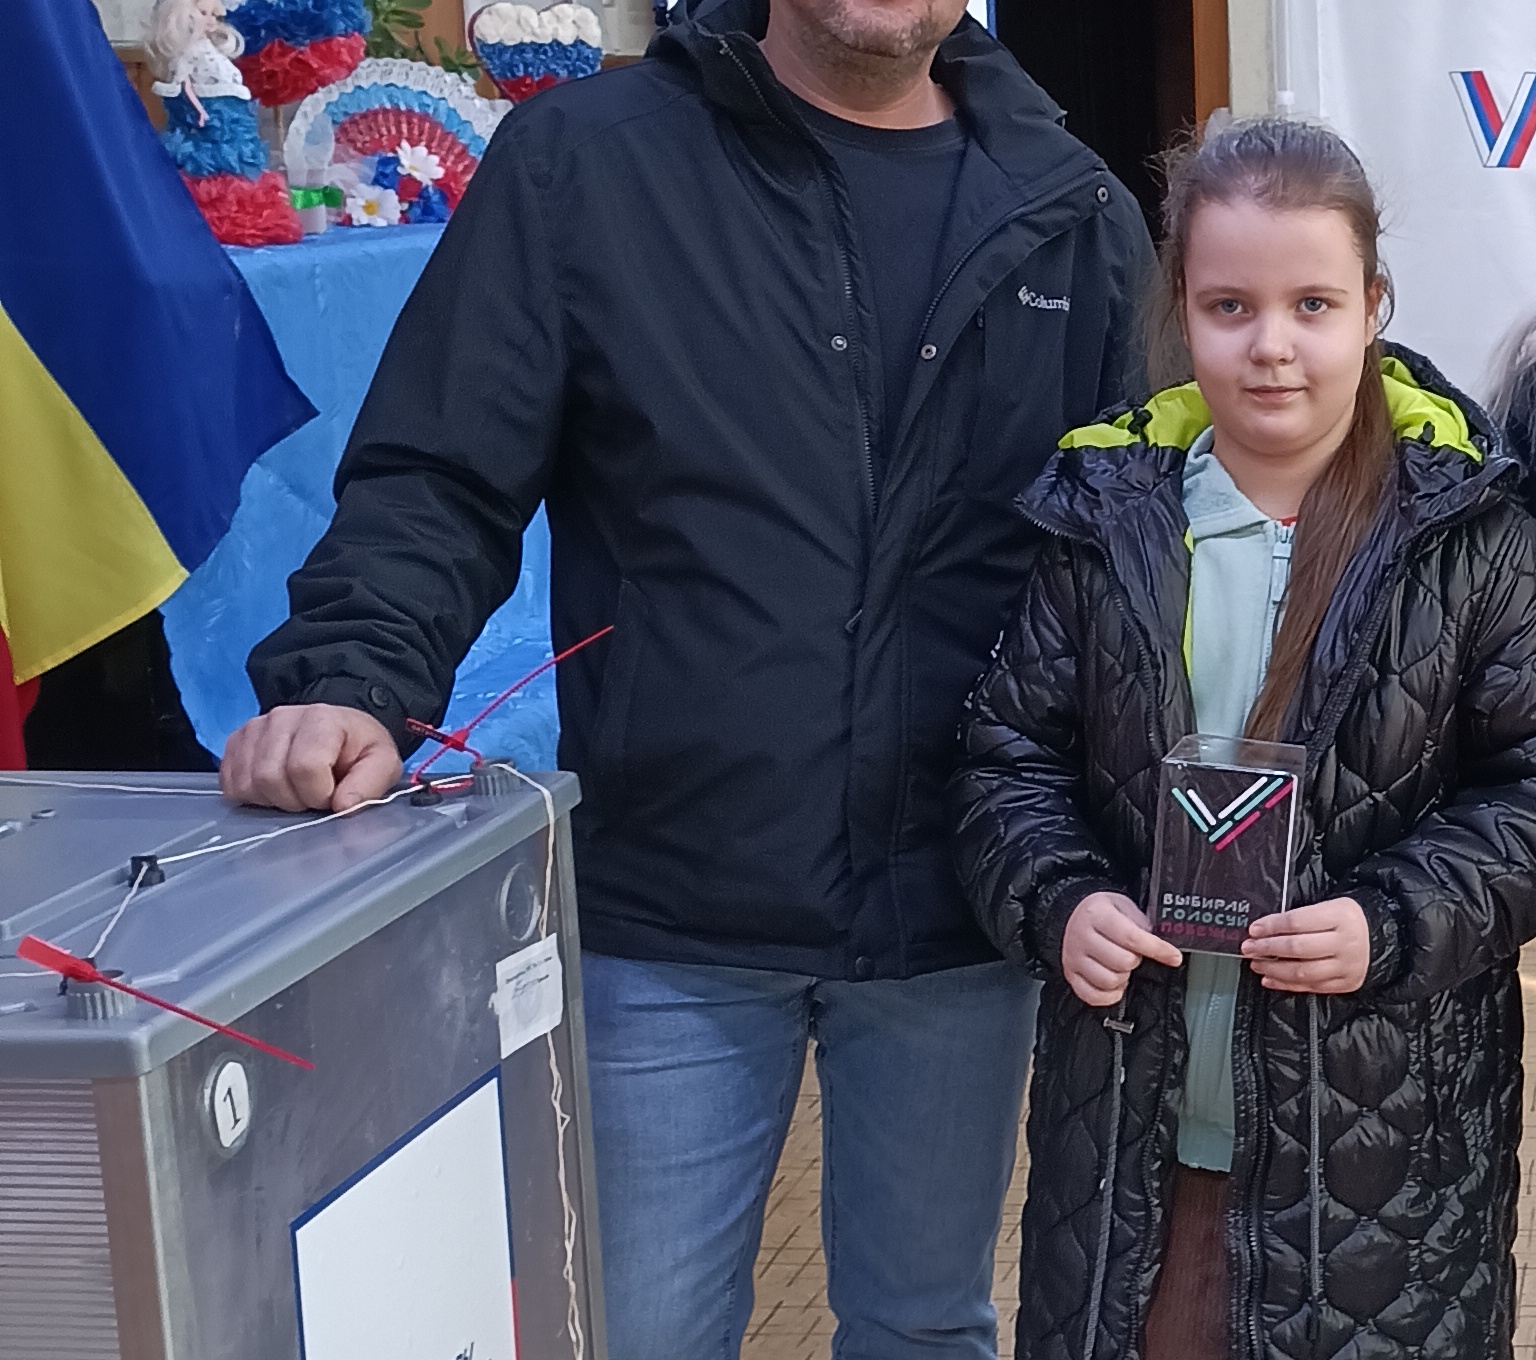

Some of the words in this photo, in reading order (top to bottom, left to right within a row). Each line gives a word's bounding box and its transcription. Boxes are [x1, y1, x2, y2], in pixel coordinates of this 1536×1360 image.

[1028, 291, 1070, 311] Columb
[1163, 893, 1250, 913] ВЫБИРАЙ
[1161, 907, 1249, 927] ГОЛОСУЙ
[223, 1087, 241, 1131] 1
